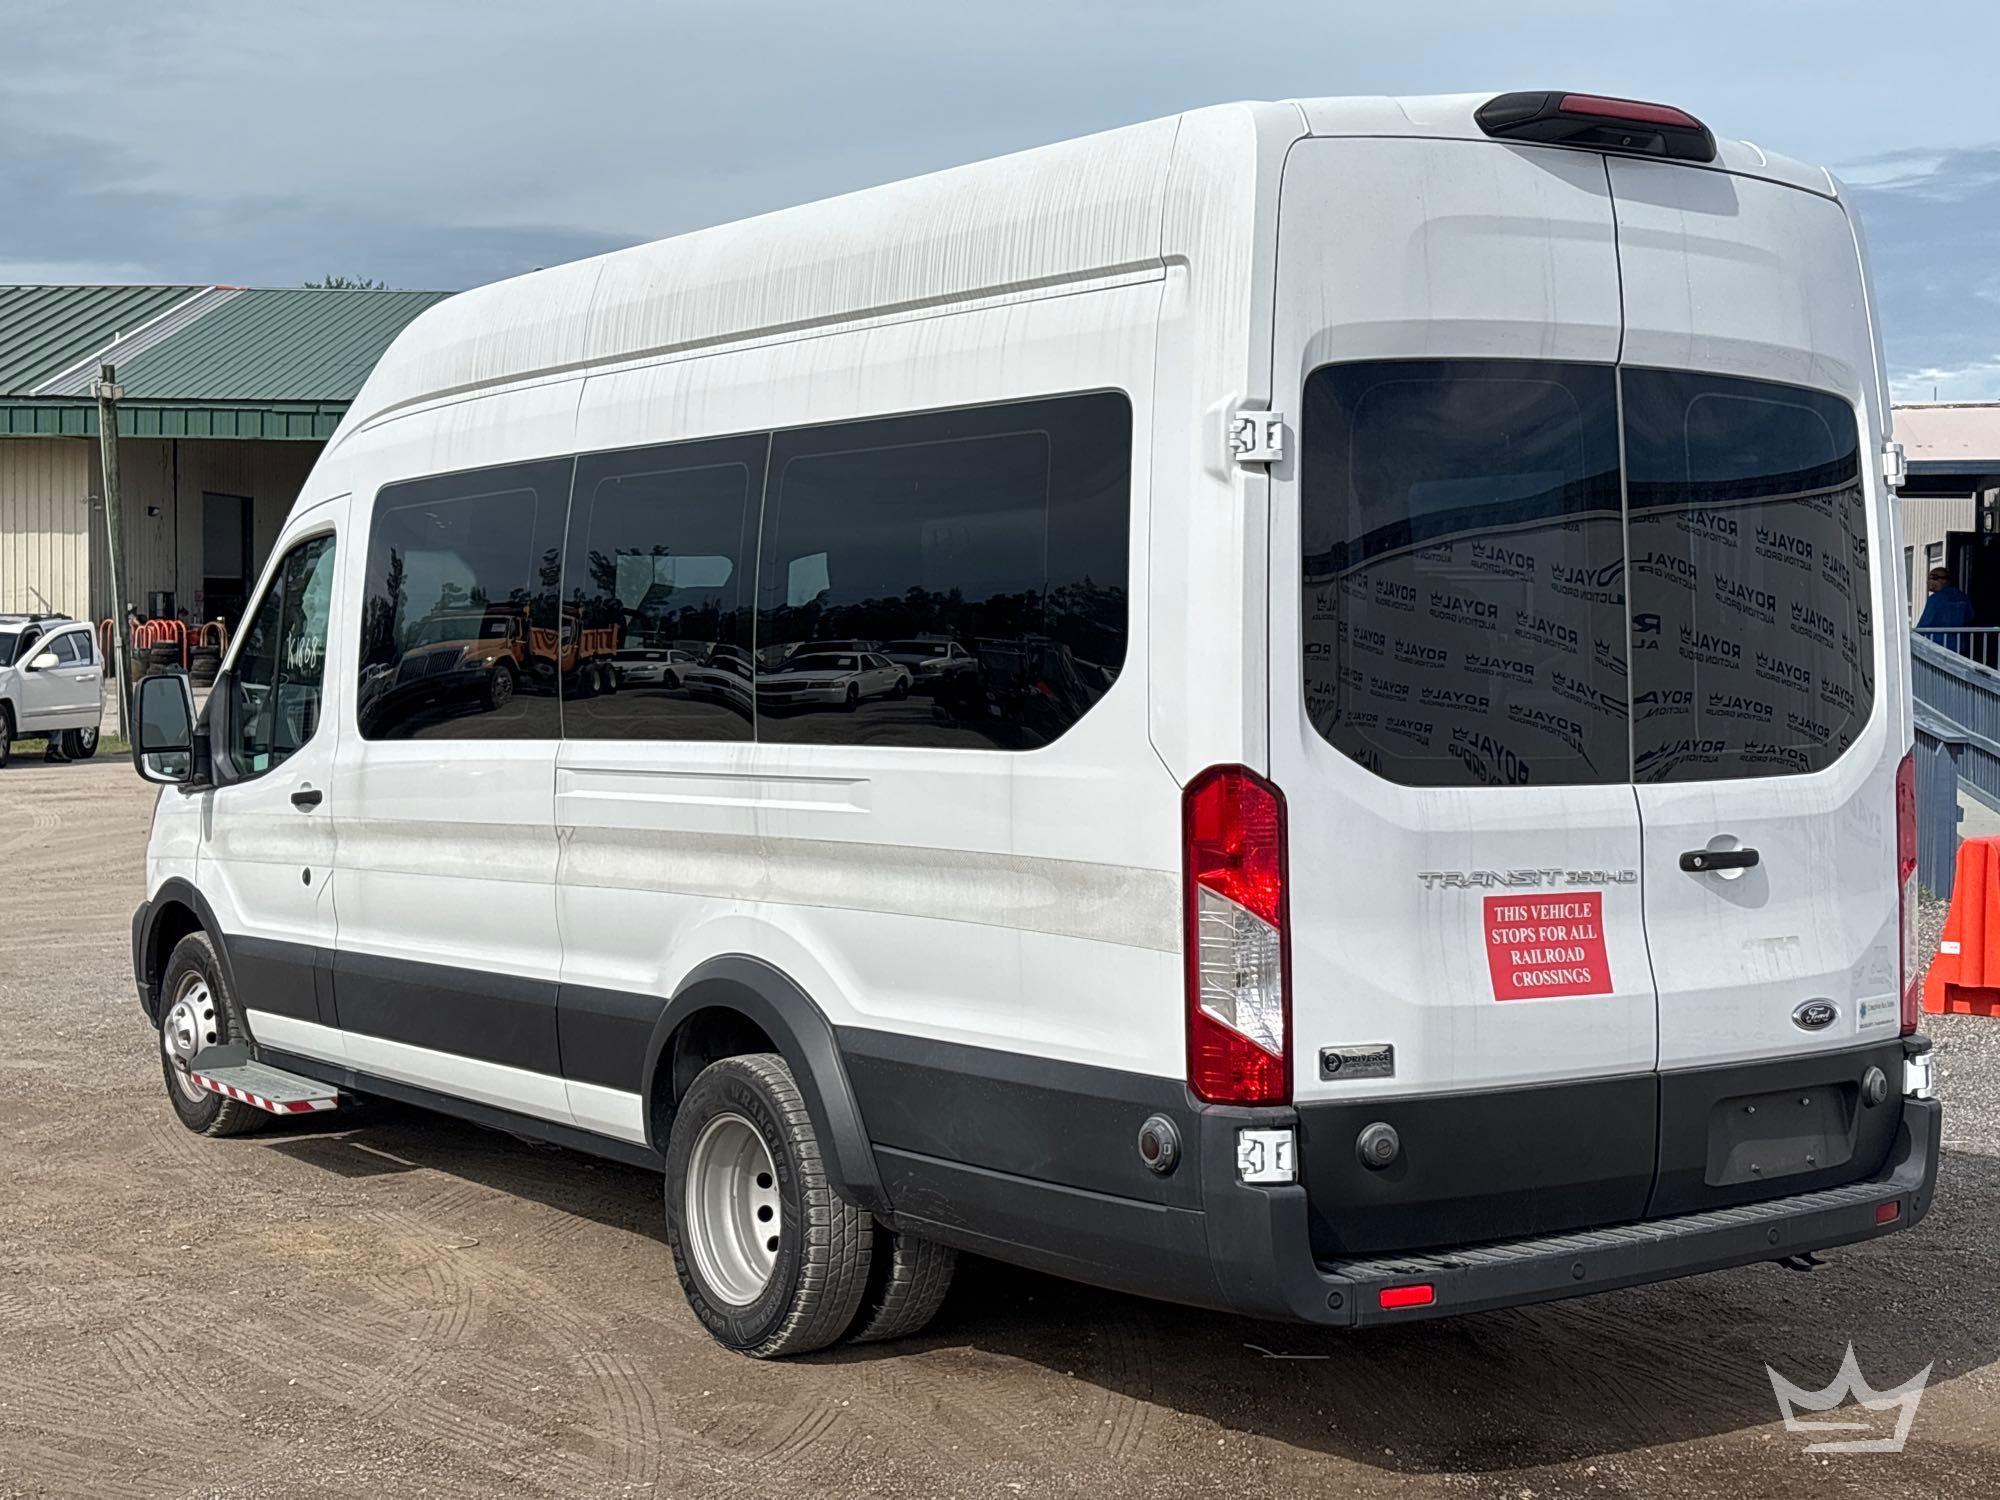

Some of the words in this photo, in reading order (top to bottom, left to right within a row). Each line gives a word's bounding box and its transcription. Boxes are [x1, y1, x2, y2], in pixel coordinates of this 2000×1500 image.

[1417, 868, 1564, 890] TRANSIT
[1565, 869, 1638, 886] 350HD
[1494, 905, 1528, 922] THIS
[1531, 902, 1592, 921] VEHICLE
[1491, 927, 1536, 945] STOPS
[1539, 925, 1568, 943] FOR
[1569, 924, 1598, 941] ALL
[1510, 946, 1585, 966] RAILROAD
[1512, 967, 1592, 988] CROSSINGS
[1805, 1006, 1831, 1024] Ford
[730, 1082, 789, 1184] WRANGLER
